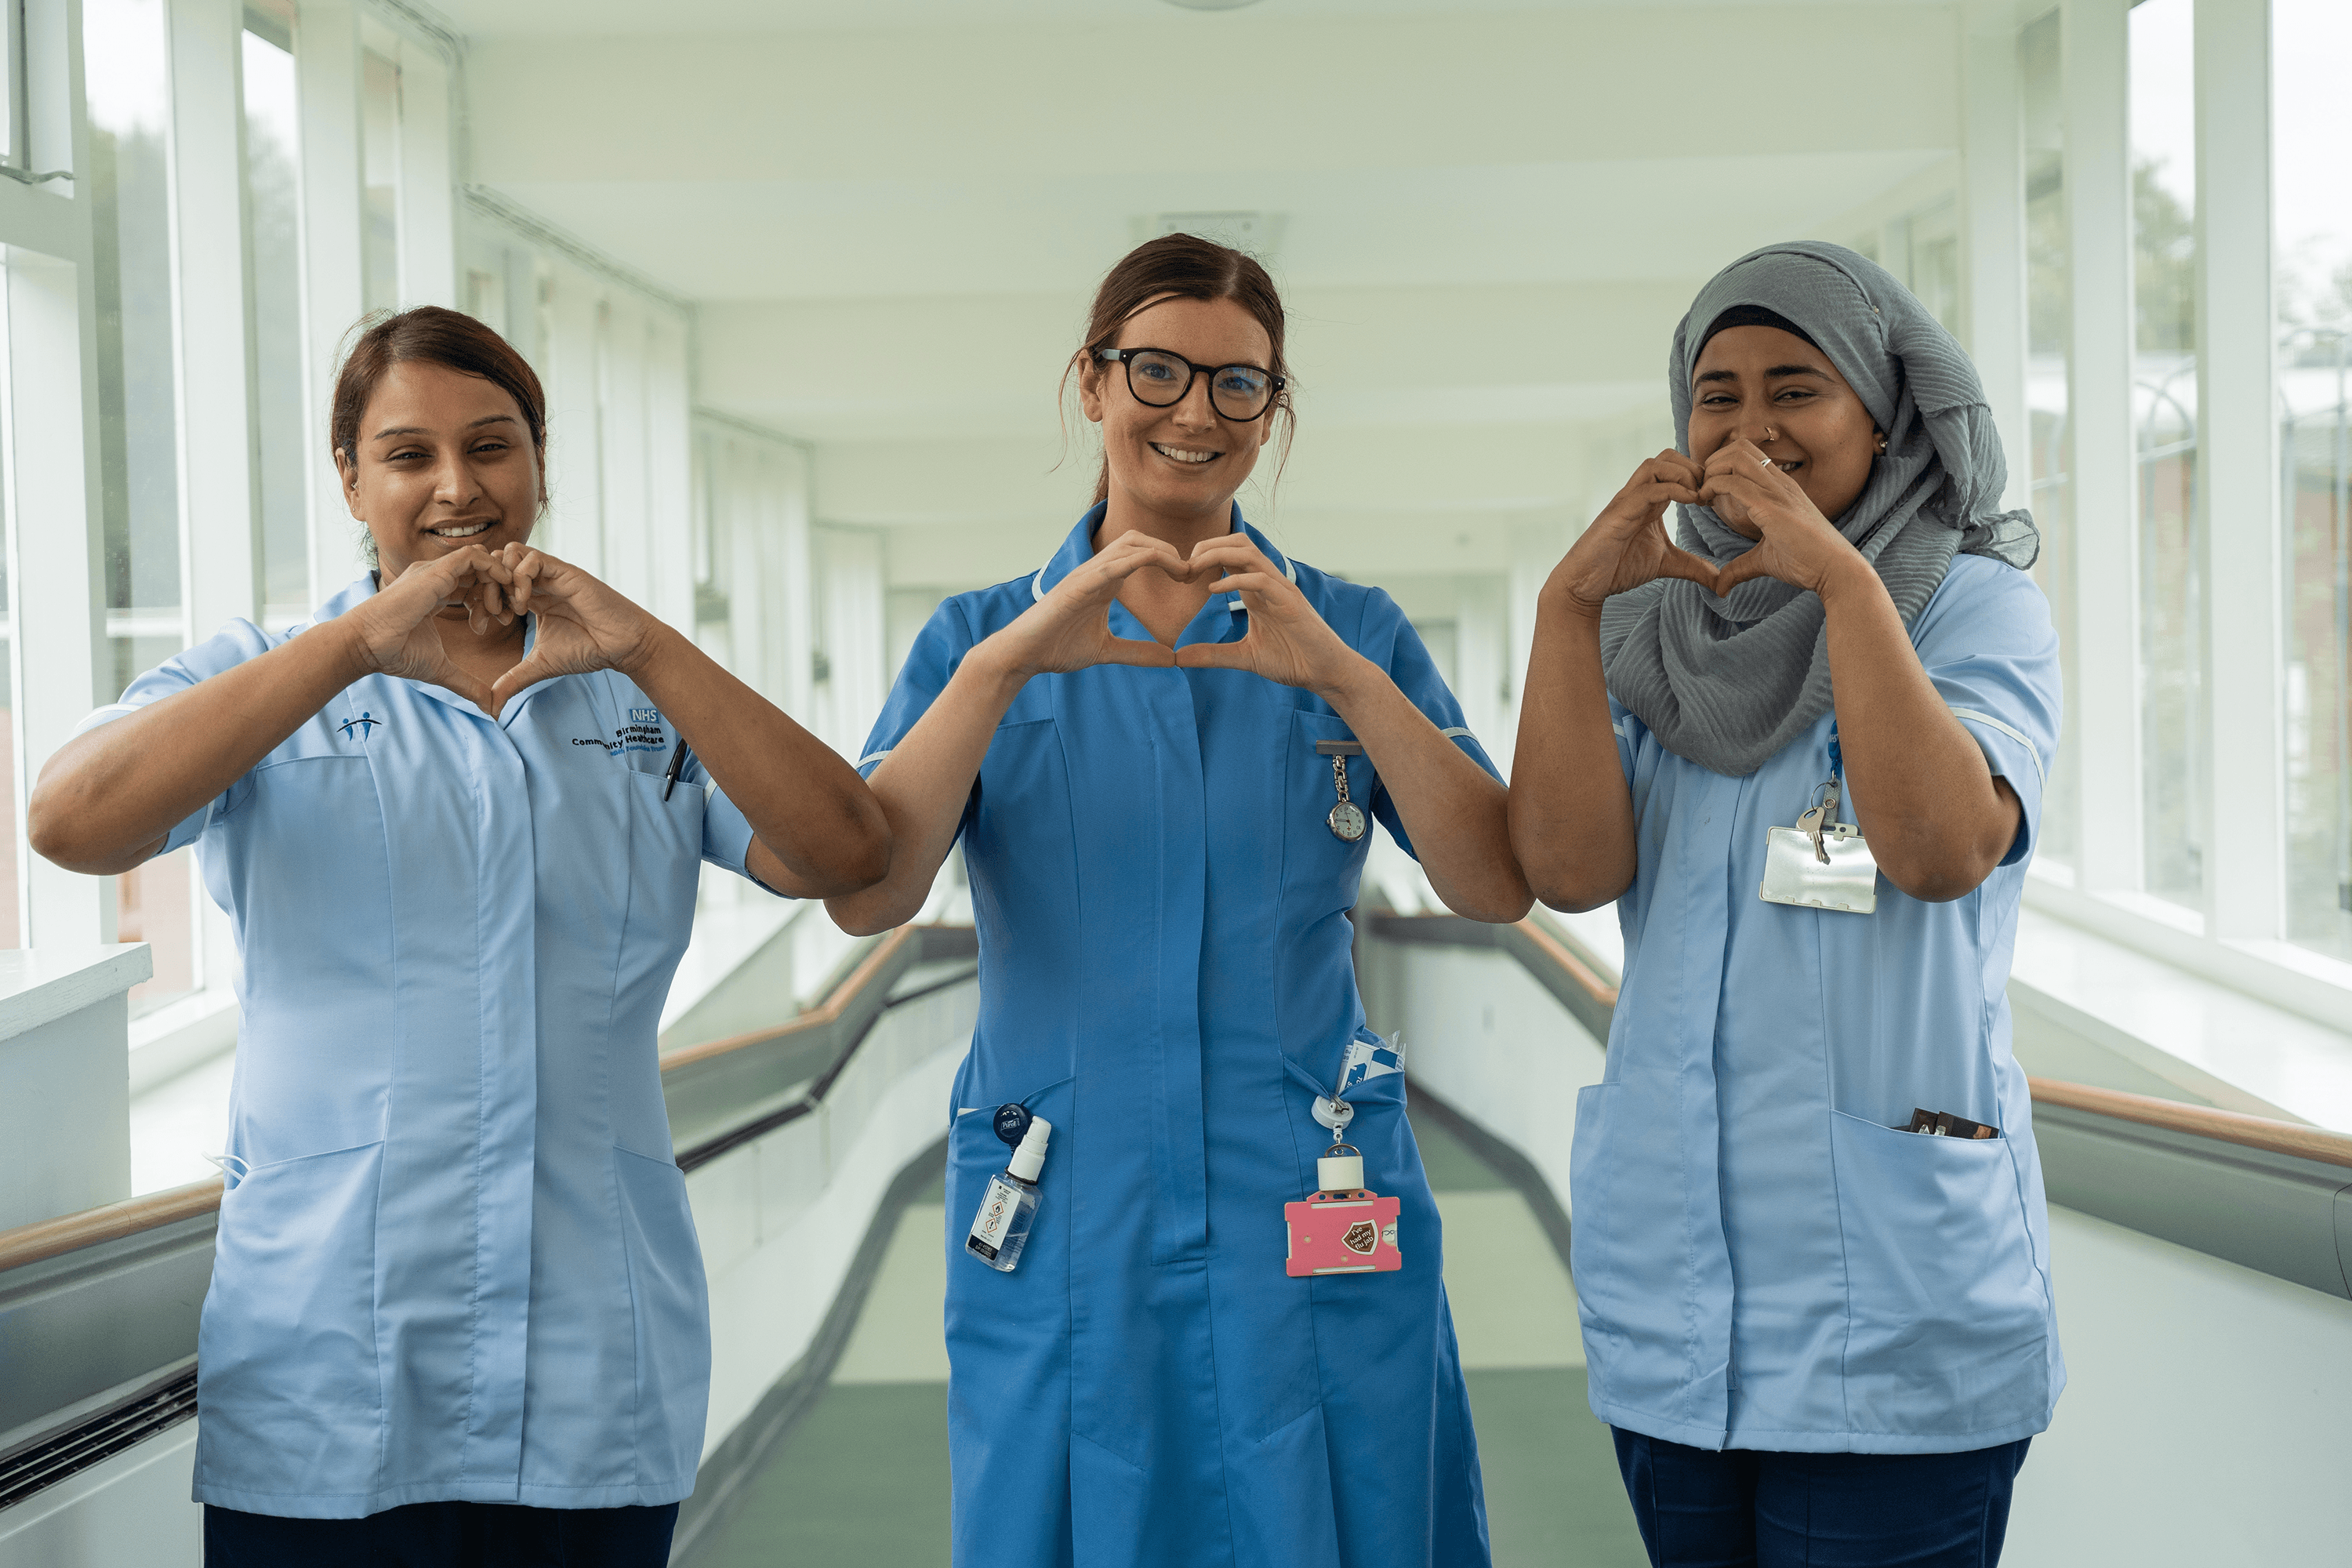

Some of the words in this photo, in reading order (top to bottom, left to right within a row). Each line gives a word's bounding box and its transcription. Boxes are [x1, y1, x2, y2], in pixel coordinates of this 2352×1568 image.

[633, 710, 657, 721] NHS
[616, 725, 661, 737] Birmingham
[625, 734, 665, 744] Healthcare
[1351, 1227, 1363, 1236] I've
[1349, 1234, 1363, 1245] had
[1362, 1229, 1371, 1238] my
[1363, 1236, 1374, 1246] jab
